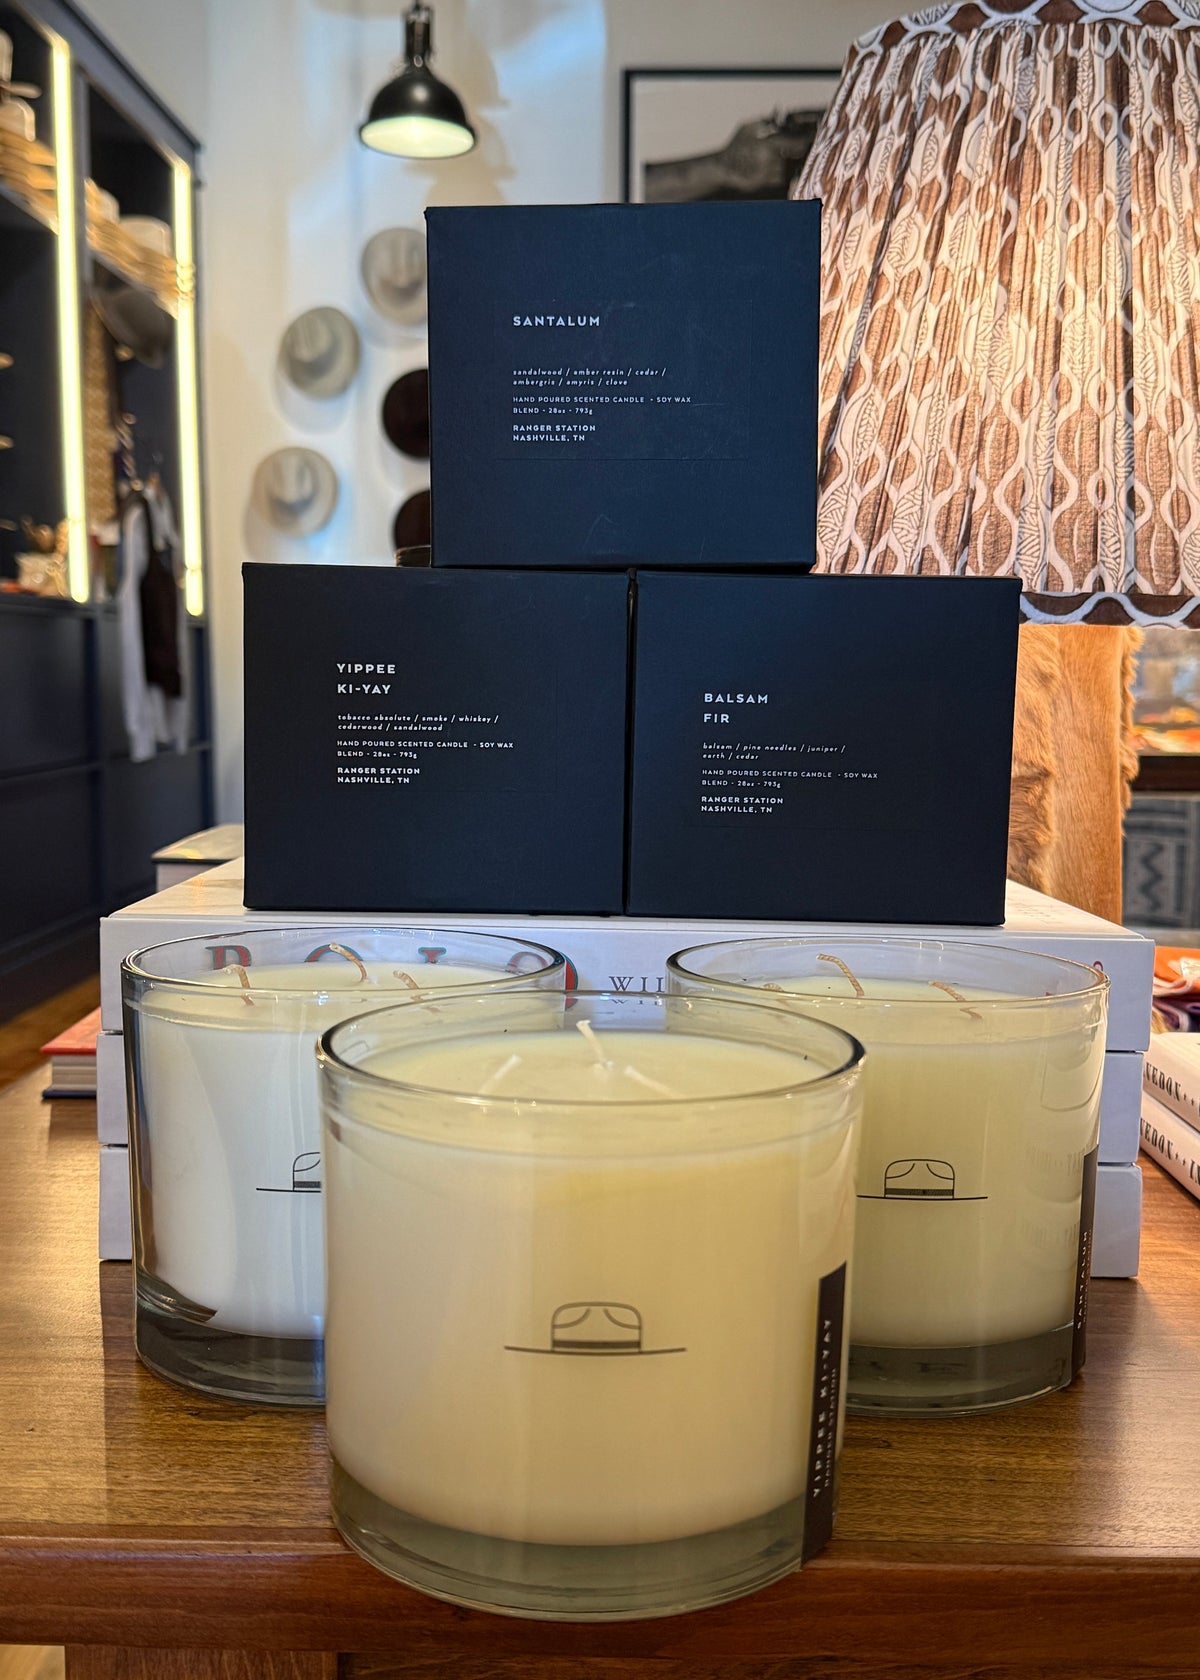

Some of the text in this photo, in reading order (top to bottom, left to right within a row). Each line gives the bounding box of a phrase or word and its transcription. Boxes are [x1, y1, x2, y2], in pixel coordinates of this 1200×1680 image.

[513, 315, 600, 327] SANTALUM
[513, 367, 563, 376] sandalwood
[573, 367, 600, 376] amber
[602, 368, 624, 376] resin
[635, 367, 659, 376] cedar
[512, 377, 555, 387] ambergris
[566, 378, 595, 387] amyris
[605, 377, 628, 386] clove
[575, 407, 593, 416] 793g
[513, 424, 596, 432] RANGER STATION
[512, 434, 585, 442] NASHVILLE, TN
[336, 663, 396, 674] YIPPEE
[337, 683, 391, 695] KI-YAY
[704, 692, 768, 704] BALSAM
[337, 713, 371, 721] tobacco
[374, 713, 411, 721] absolute
[422, 714, 448, 722] smoke
[458, 714, 491, 724] whiskey
[703, 713, 730, 724] FIR
[337, 722, 383, 731] cedarwood
[393, 723, 443, 731] sandalwood
[397, 740, 434, 748] SCENTED
[702, 742, 733, 750] balsam
[742, 743, 762, 752] pine
[764, 743, 797, 751] needles
[807, 745, 838, 753] juniper
[399, 751, 418, 760] 793g
[735, 752, 759, 760] cedar
[379, 767, 420, 775] STATION
[726, 769, 760, 777] POURED
[337, 776, 395, 784] NASHVILLE,
[763, 781, 781, 789] 793g
[701, 796, 784, 804] RANGER STATION
[701, 805, 758, 814] NASHVILLE,
